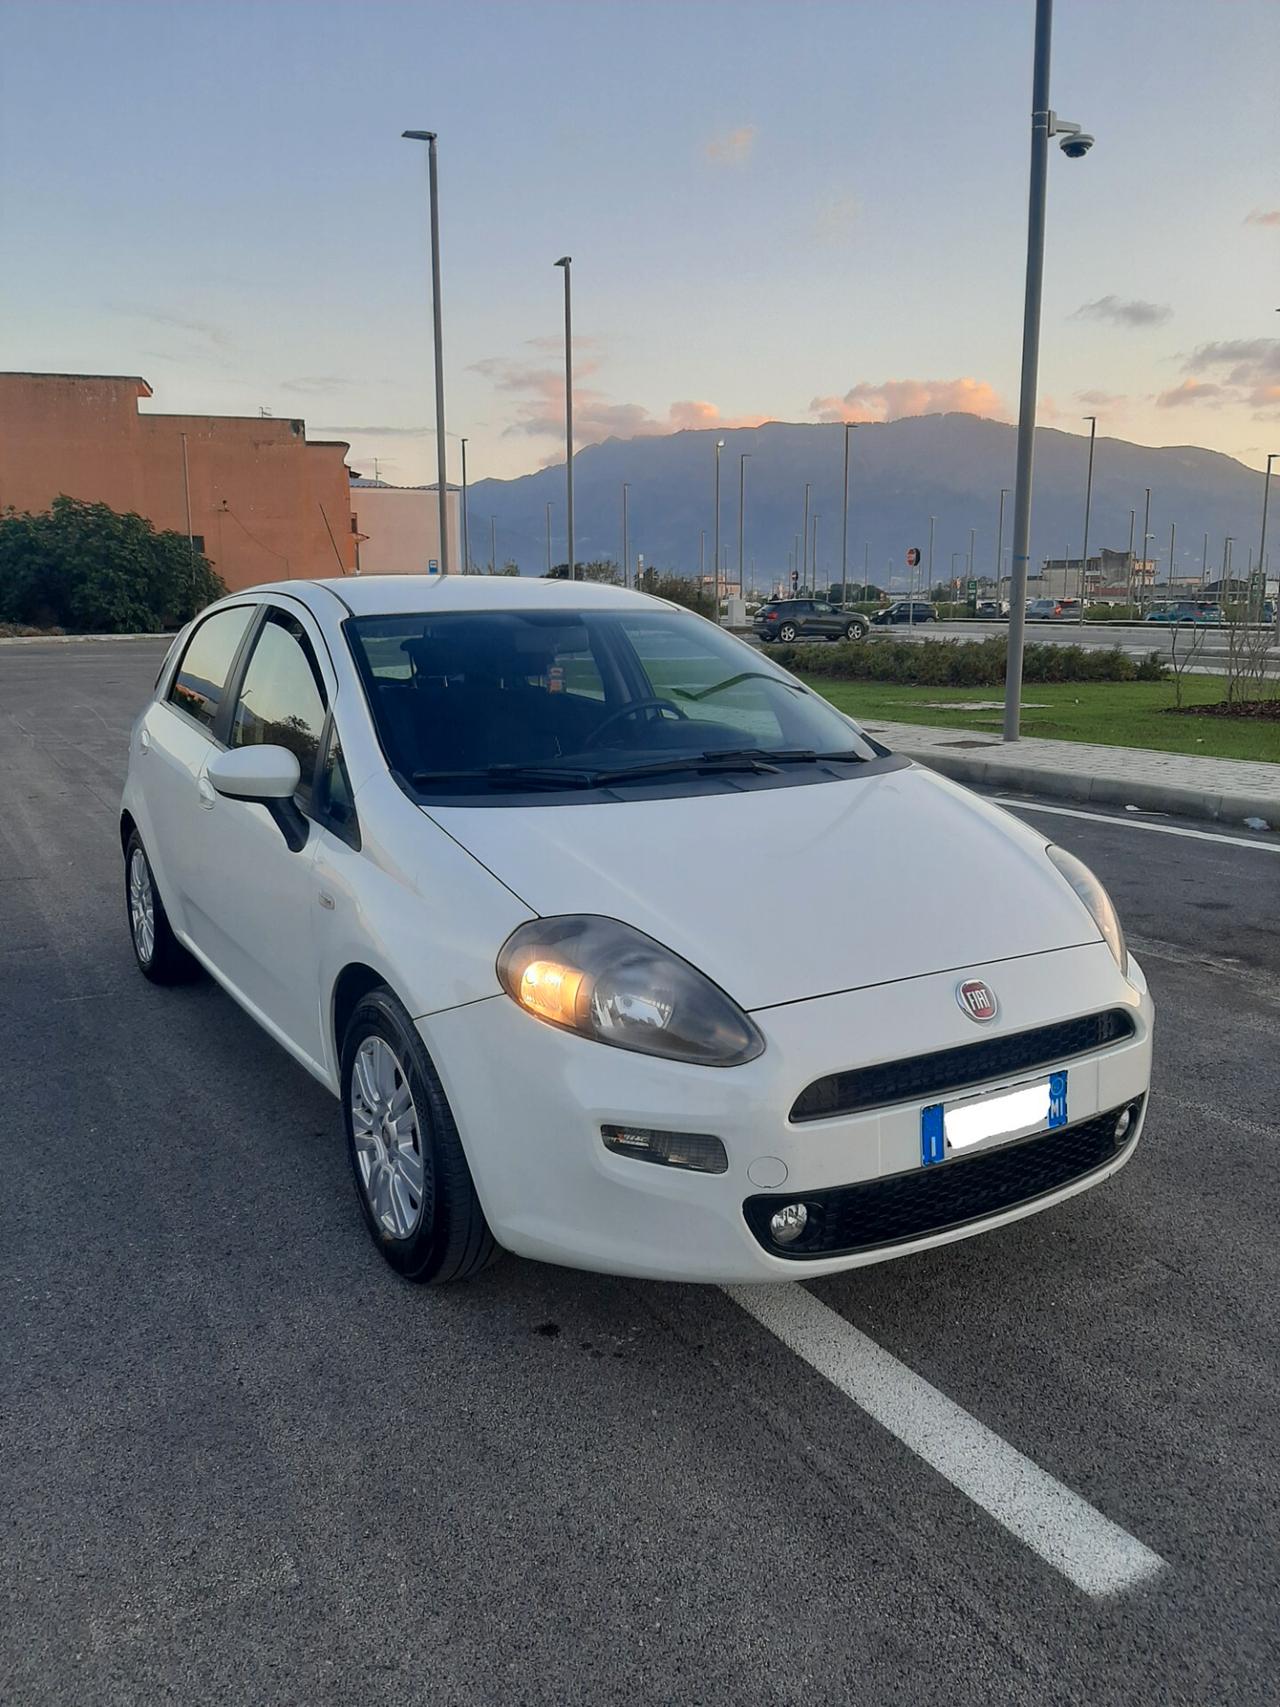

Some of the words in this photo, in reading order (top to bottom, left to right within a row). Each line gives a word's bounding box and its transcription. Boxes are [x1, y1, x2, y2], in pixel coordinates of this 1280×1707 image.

[966, 989, 991, 1011] FIAT
[1050, 1096, 1063, 1120] MI
[930, 1136, 937, 1157] I
